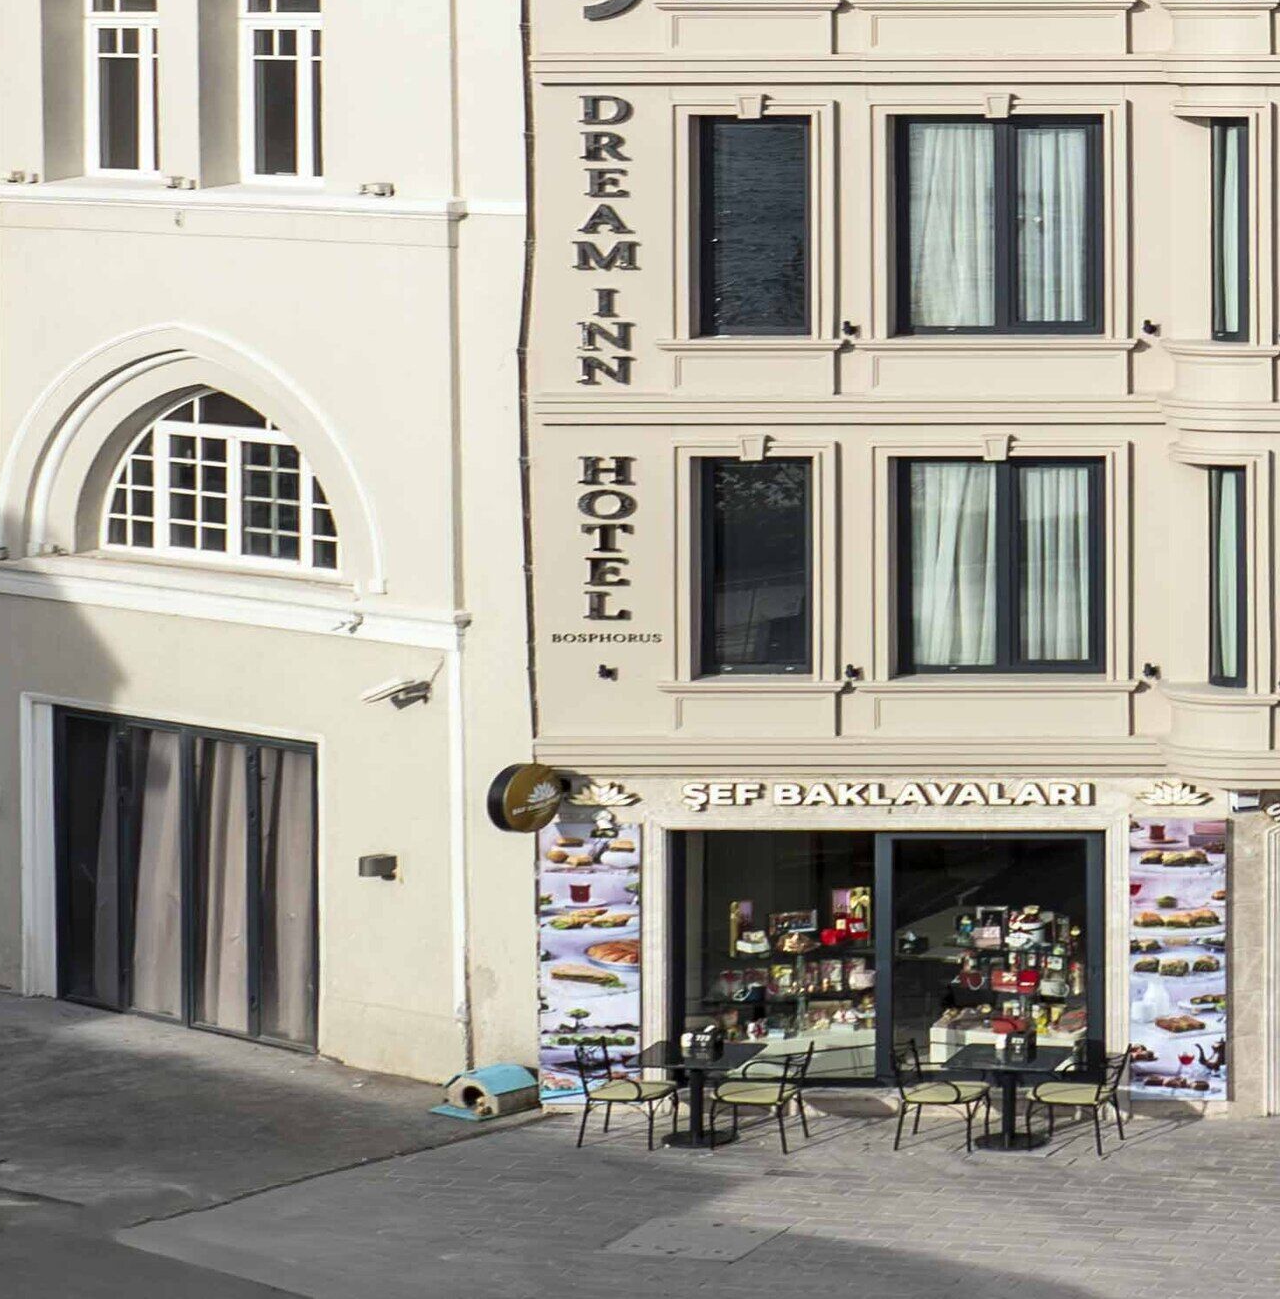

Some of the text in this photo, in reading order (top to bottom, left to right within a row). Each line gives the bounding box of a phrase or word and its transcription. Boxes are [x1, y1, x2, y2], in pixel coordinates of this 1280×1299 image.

[572, 95, 643, 386] DREAM INN
[577, 456, 638, 621] HOTEL
[551, 633, 663, 644] BOSPHORUS
[682, 782, 1095, 812] ŞEF BAKLAVALARI
